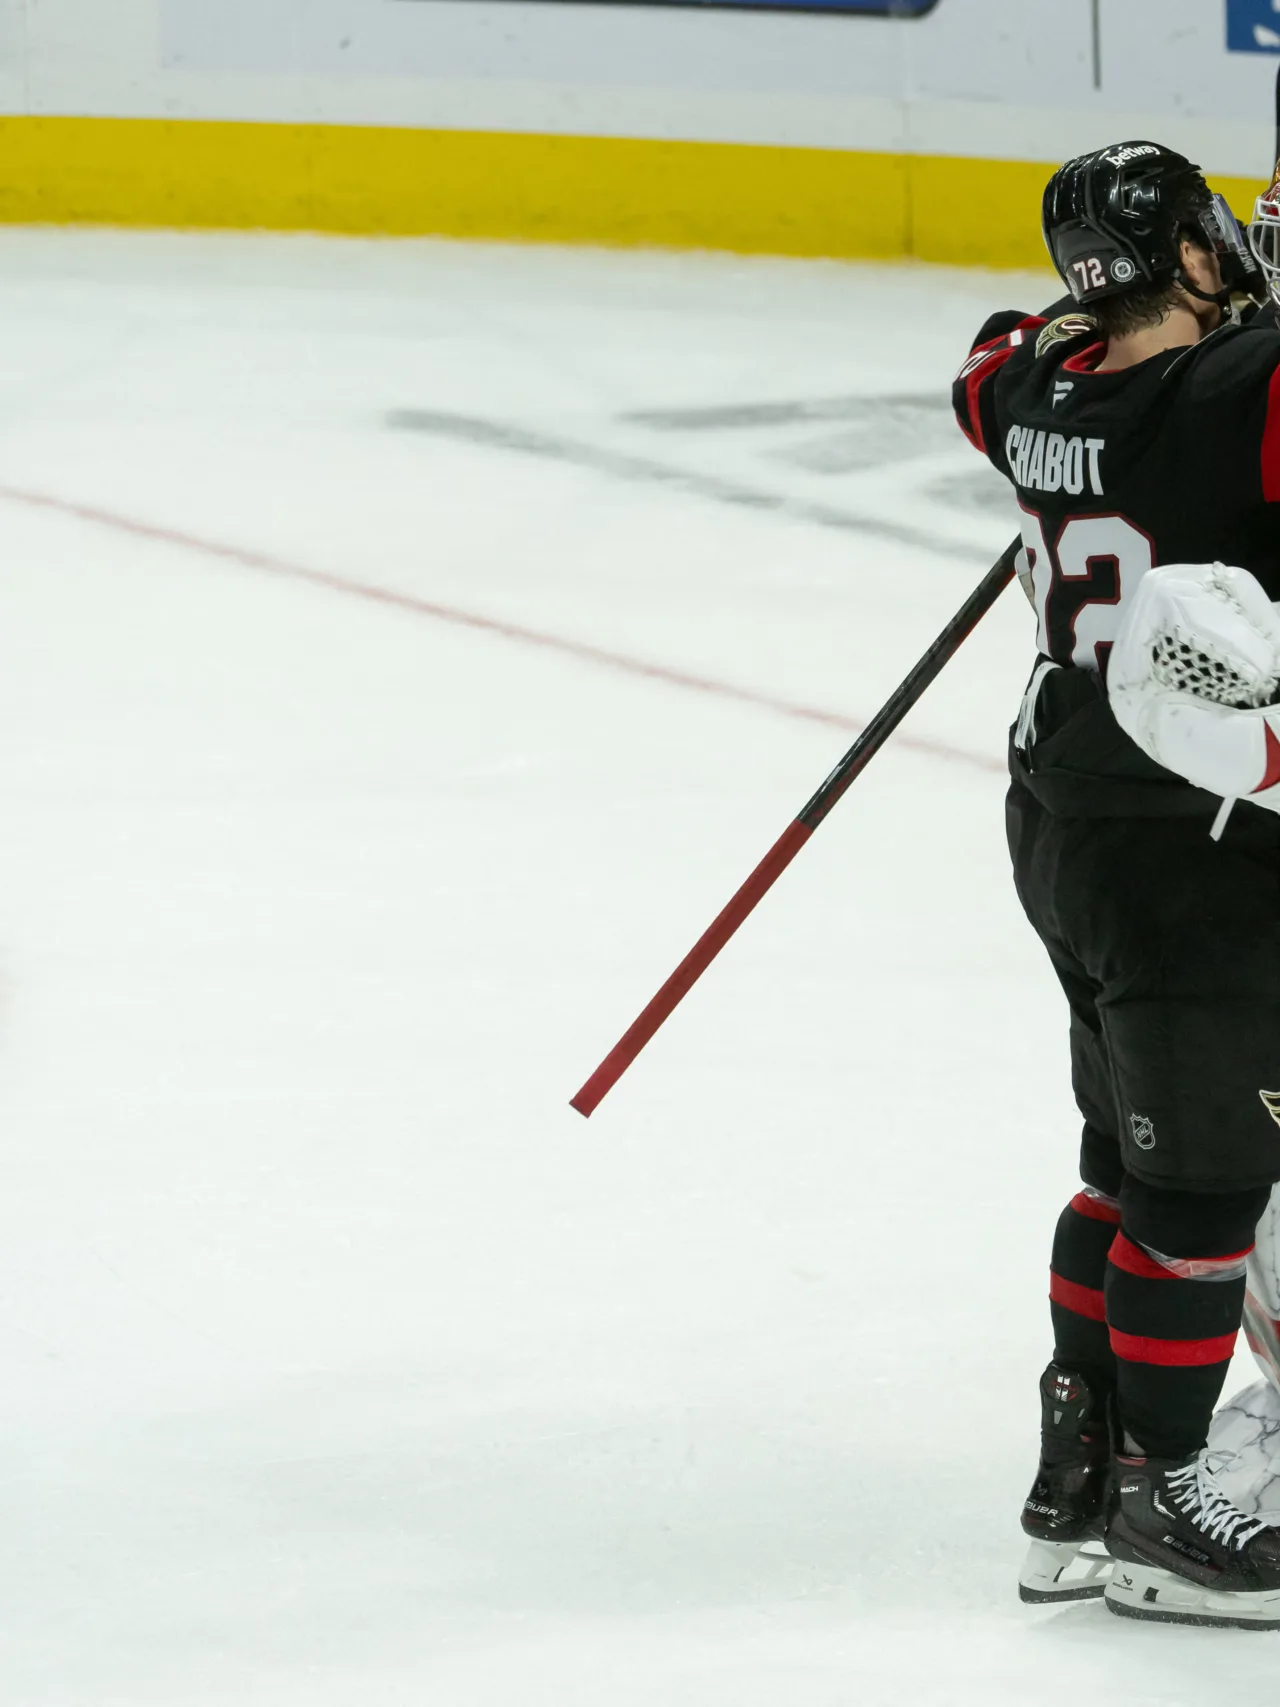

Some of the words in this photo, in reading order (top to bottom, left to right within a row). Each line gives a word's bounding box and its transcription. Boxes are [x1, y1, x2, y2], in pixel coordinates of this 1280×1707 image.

[1105, 144, 1160, 169] betway
[1073, 257, 1107, 291] 72
[1005, 424, 1105, 496] CHABOT
